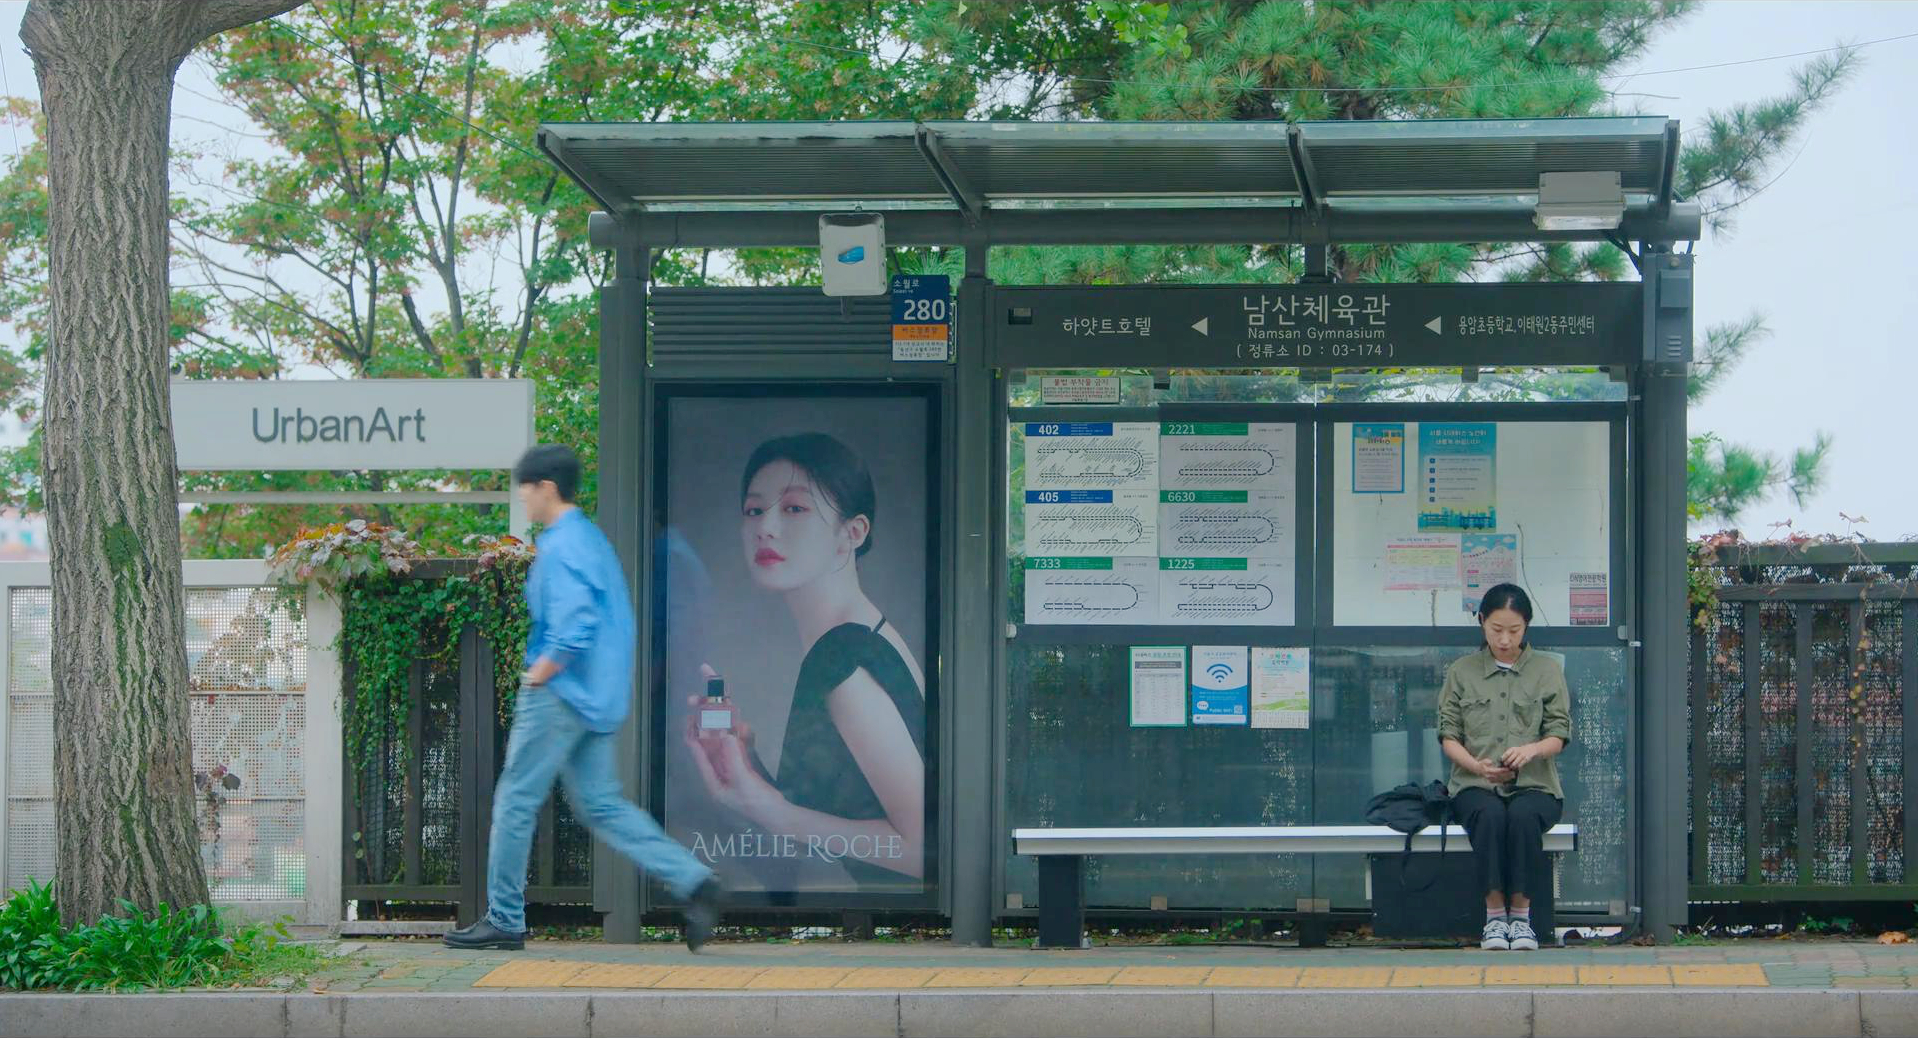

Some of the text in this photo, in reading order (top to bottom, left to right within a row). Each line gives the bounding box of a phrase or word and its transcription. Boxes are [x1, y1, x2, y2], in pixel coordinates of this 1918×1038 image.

[904, 299, 945, 320] 280
[1243, 294, 1391, 326] 남산체육관
[1062, 316, 1151, 336] 하얏트호텔
[1248, 327, 1385, 341] Namsan Gymnasium
[1249, 344, 1290, 359] 정류소
[1297, 344, 1312, 356] ID
[1332, 344, 1382, 356] 03-174
[252, 406, 426, 443] UrbanArt
[1038, 424, 1059, 436] 402
[1168, 424, 1196, 435] 2221
[1038, 491, 1059, 502] 405
[1167, 491, 1196, 502] 6630
[1034, 558, 1061, 569] 7333
[1167, 559, 1195, 570] 1225
[691, 828, 903, 863] AMÉLIE ROCHE
